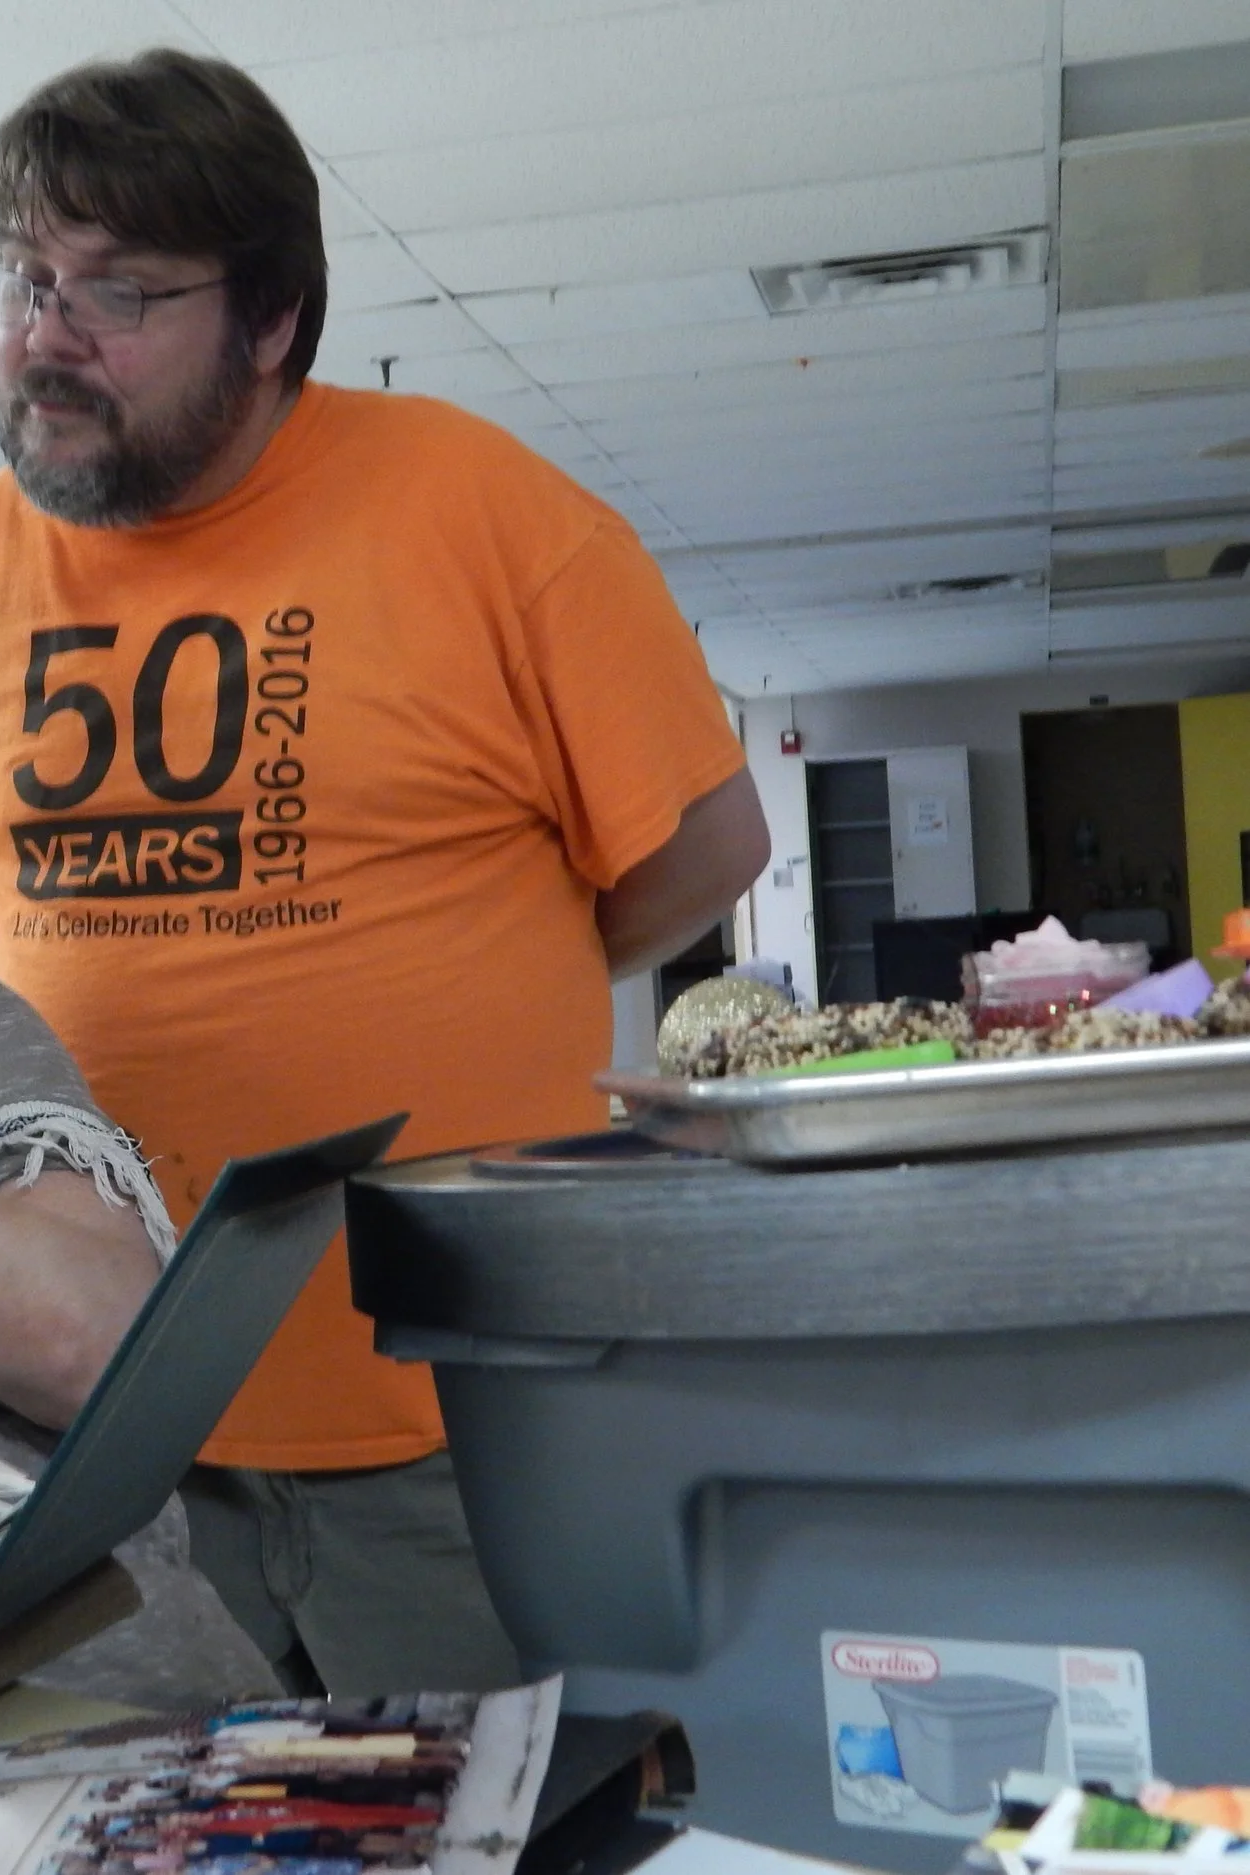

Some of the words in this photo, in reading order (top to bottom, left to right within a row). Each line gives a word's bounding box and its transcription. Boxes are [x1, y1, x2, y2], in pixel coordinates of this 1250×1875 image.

[13, 612, 250, 811] 50
[255, 605, 315, 885] 1966-2016
[12, 911, 49, 939] Let's
[56, 909, 190, 938] Celebrate
[199, 898, 342, 937] Together
[24, 826, 225, 890] YEARS
